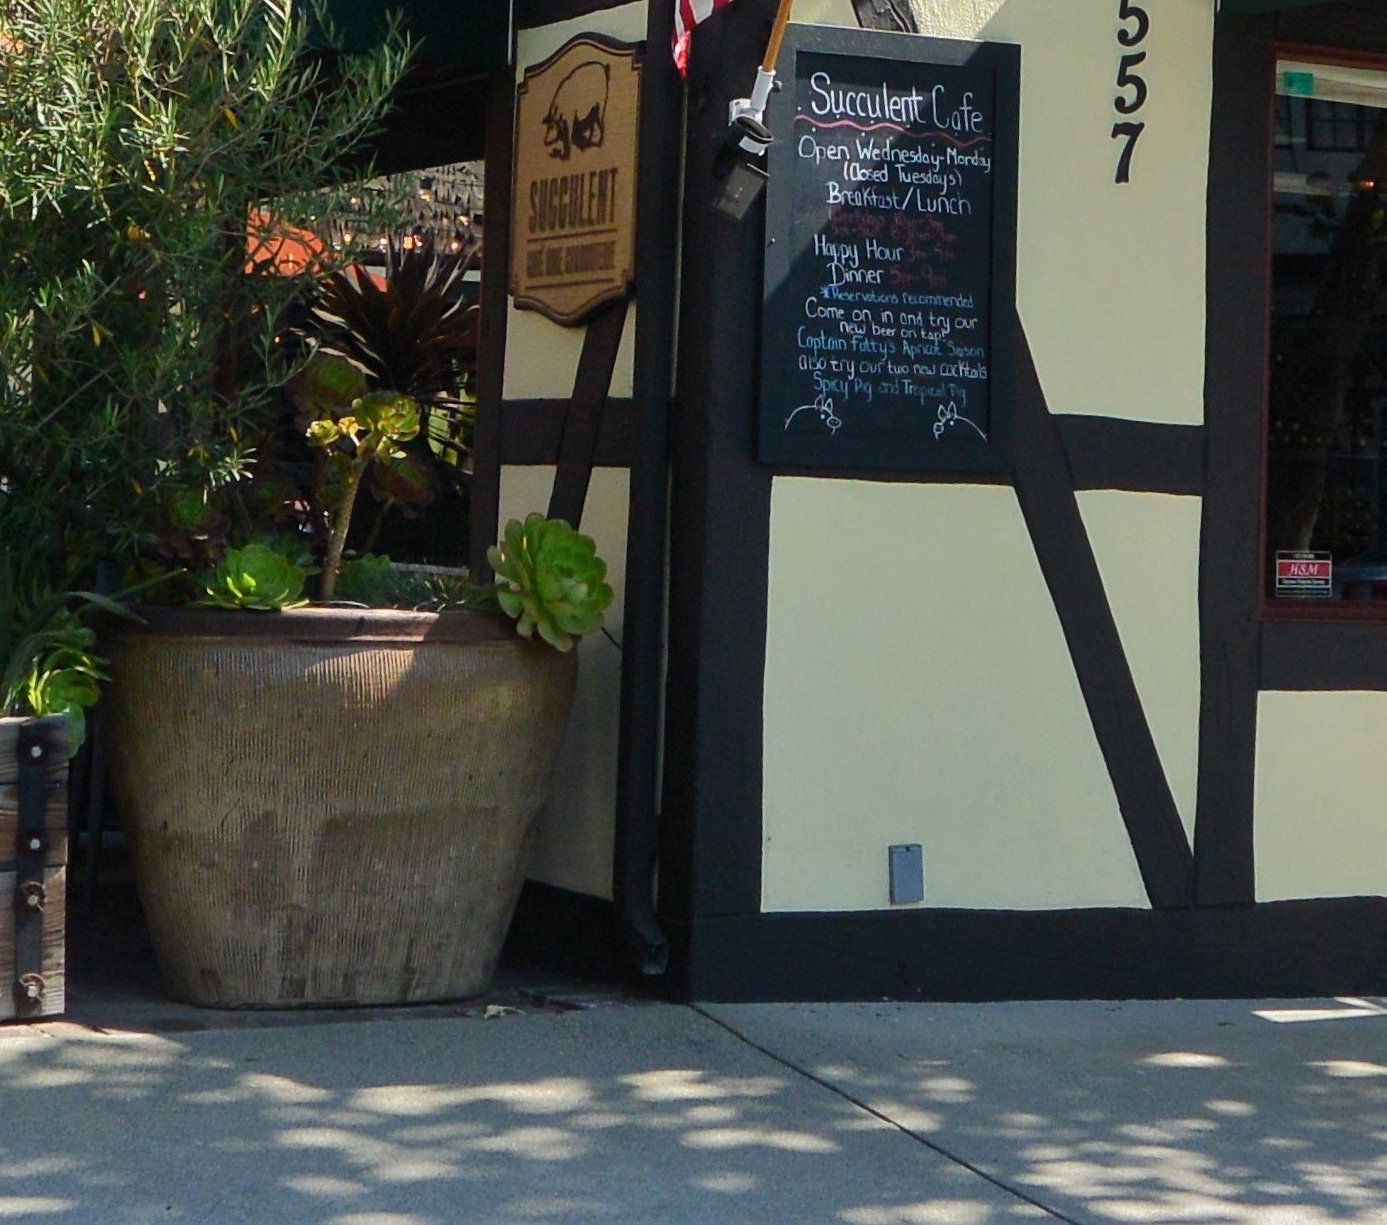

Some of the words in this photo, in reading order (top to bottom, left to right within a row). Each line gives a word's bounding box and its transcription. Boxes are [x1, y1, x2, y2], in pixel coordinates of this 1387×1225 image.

[810, 71, 926, 124] Succulent
[932, 84, 983, 133] Cafe
[798, 135, 850, 165] Open
[814, 234, 859, 268] Happy
[866, 239, 904, 261] Hour
[826, 262, 884, 286] Dinner
[902, 291, 973, 309] recommended
[805, 296, 845, 319] Come
[852, 309, 872, 322] on
[880, 308, 894, 324] in
[900, 312, 923, 327] and
[929, 312, 950, 334] try
[954, 316, 978, 330] our
[797, 326, 847, 356] Captain
[839, 321, 867, 335] new
[872, 321, 896, 337] beer
[901, 329, 917, 339] on
[799, 355, 827, 371] also
[830, 356, 855, 380] try
[859, 359, 883, 373] our
[887, 360, 910, 375] two
[813, 371, 848, 399] Spicy
